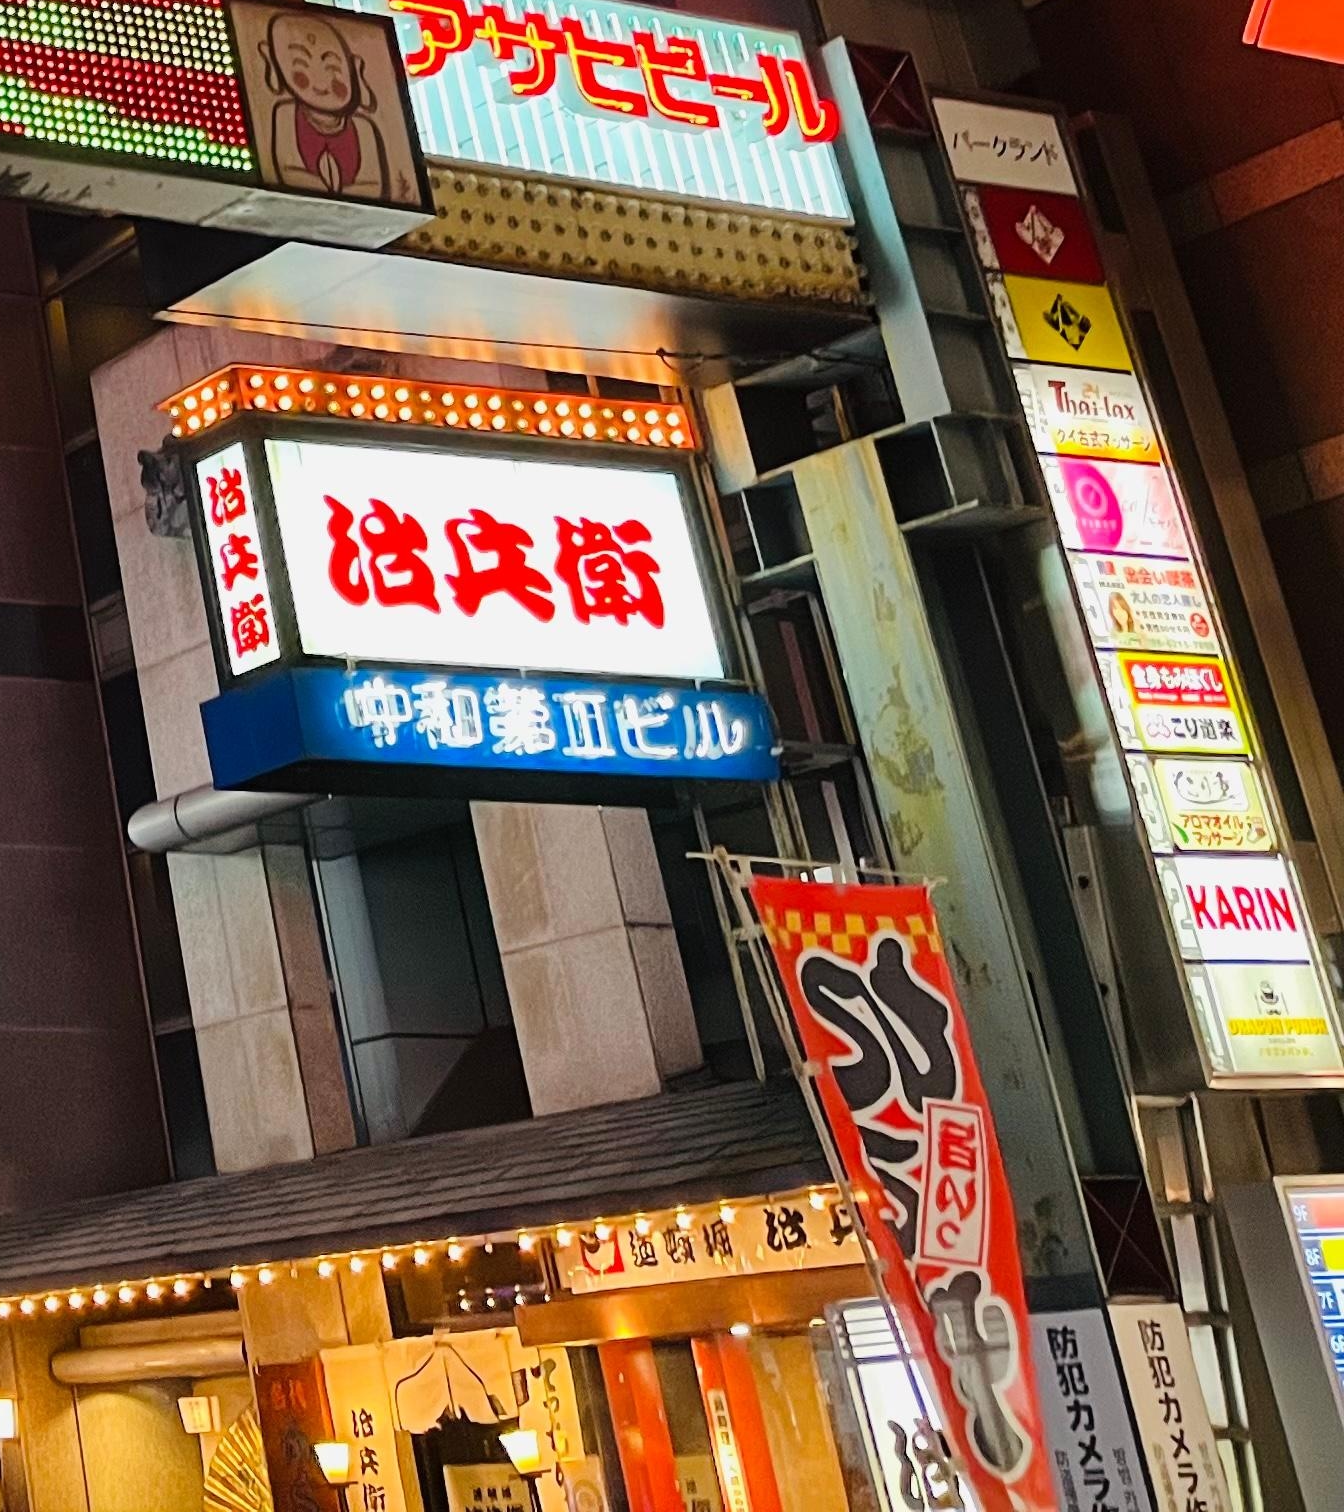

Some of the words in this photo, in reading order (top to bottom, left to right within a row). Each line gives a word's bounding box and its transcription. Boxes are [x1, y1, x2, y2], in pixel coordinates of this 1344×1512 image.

[205, 466, 272, 660] 治兵衛
[322, 494, 667, 630] 治兵衛
[1186, 884, 1298, 933] KARIN
[1292, 1204, 1309, 1223] 9F
[1304, 1247, 1321, 1267] 8F
[1317, 1290, 1334, 1310] 7F
[1046, 1326, 1120, 1512] 防犯カメラ
